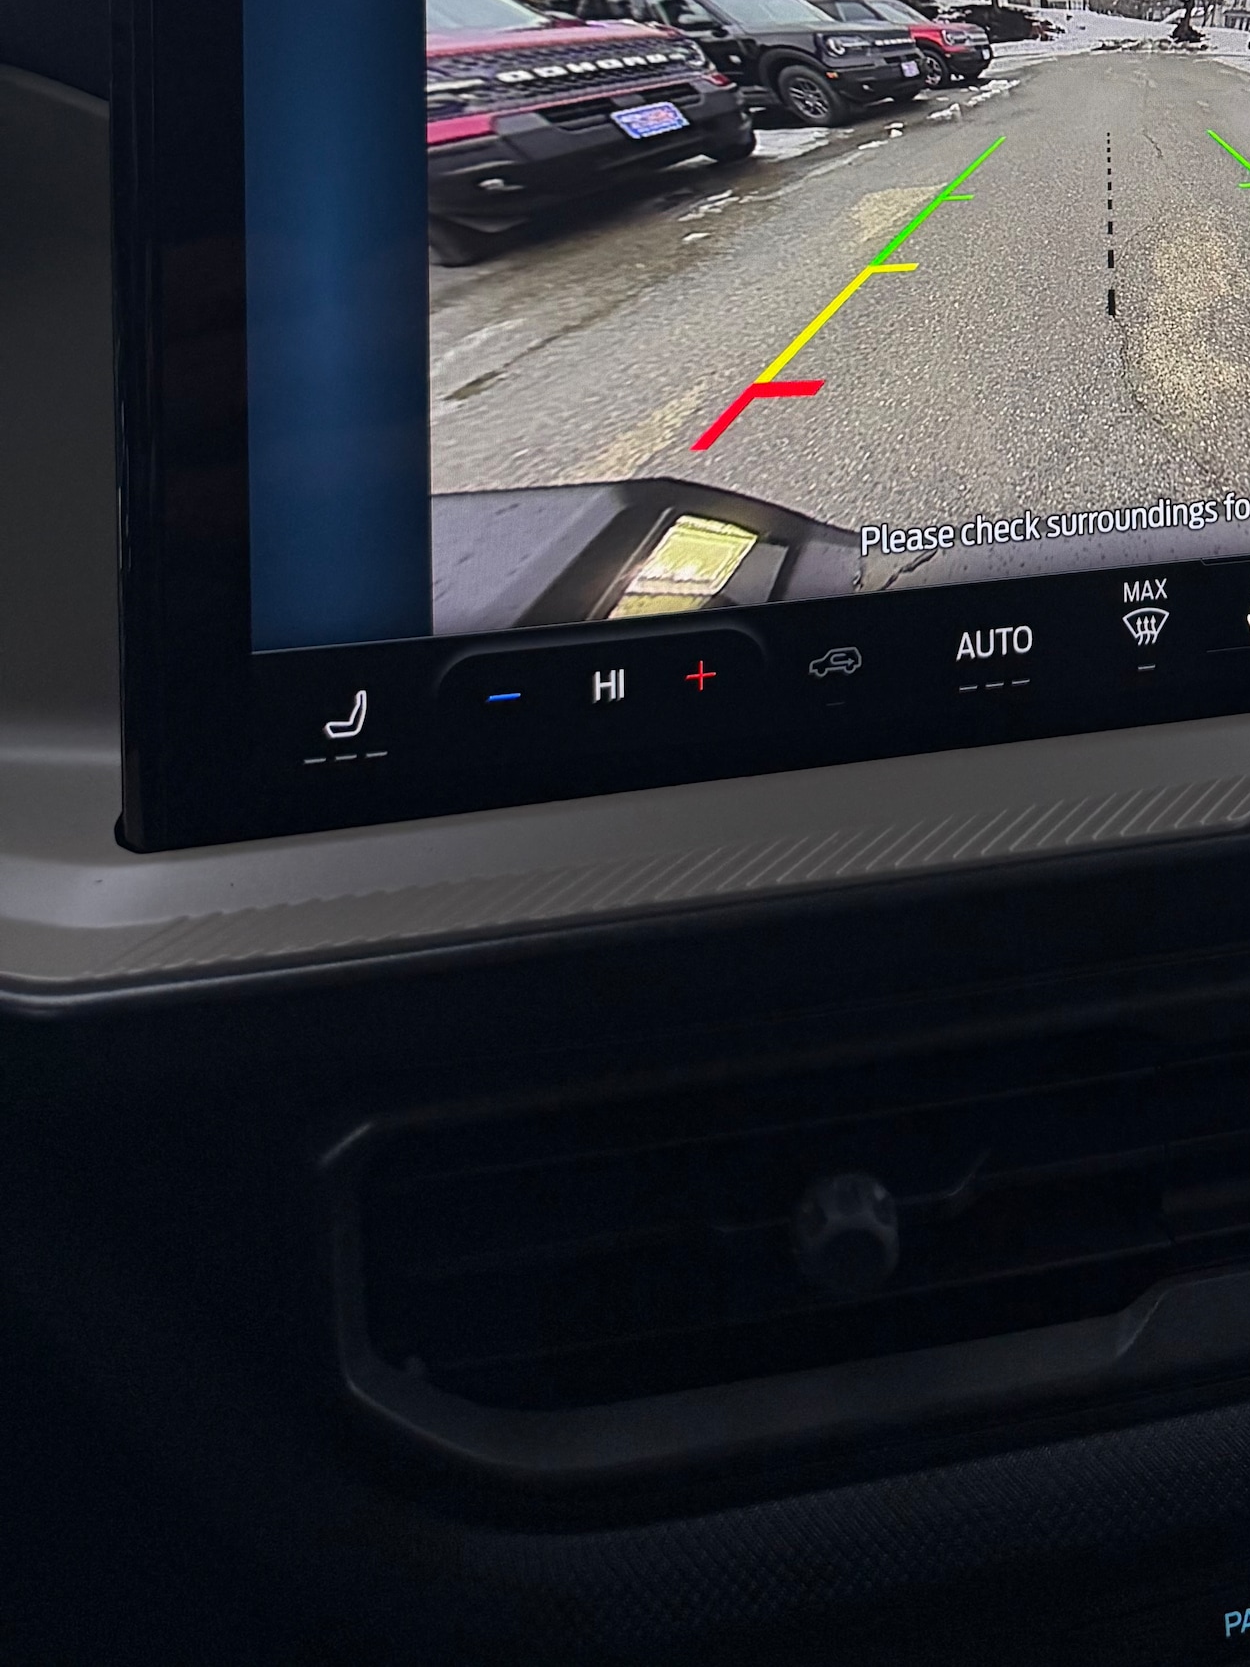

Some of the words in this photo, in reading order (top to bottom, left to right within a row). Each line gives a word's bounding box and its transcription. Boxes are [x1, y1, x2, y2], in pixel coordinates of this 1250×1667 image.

[860, 523, 954, 557] Please
[960, 510, 1041, 546] check
[1046, 498, 1218, 539] surroundings
[1122, 577, 1168, 604] MAX
[955, 625, 1033, 662] AUTO
[593, 668, 626, 703] HI
